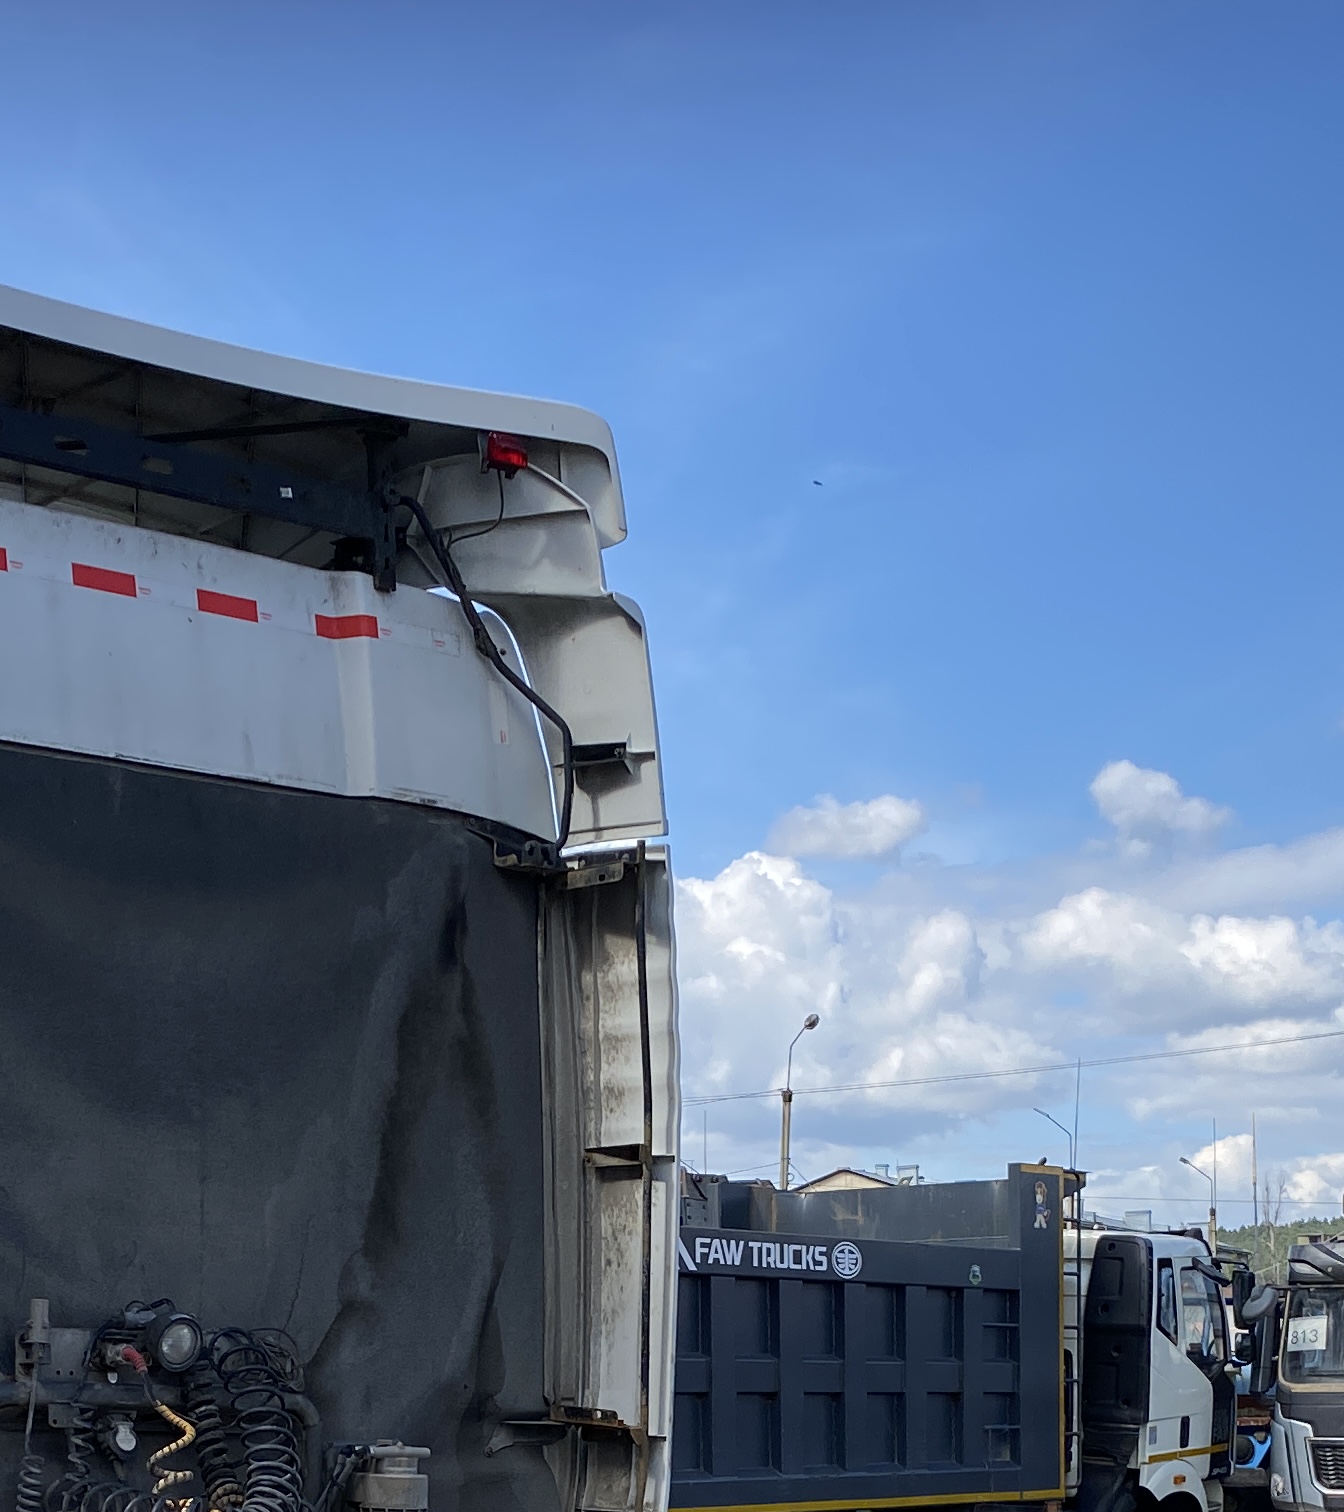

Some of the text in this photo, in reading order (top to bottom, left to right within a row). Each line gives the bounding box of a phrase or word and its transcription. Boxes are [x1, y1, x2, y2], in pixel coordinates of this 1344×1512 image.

[695, 1237, 828, 1271] FAW TRUCKS
[1290, 1328, 1319, 1345] 813
